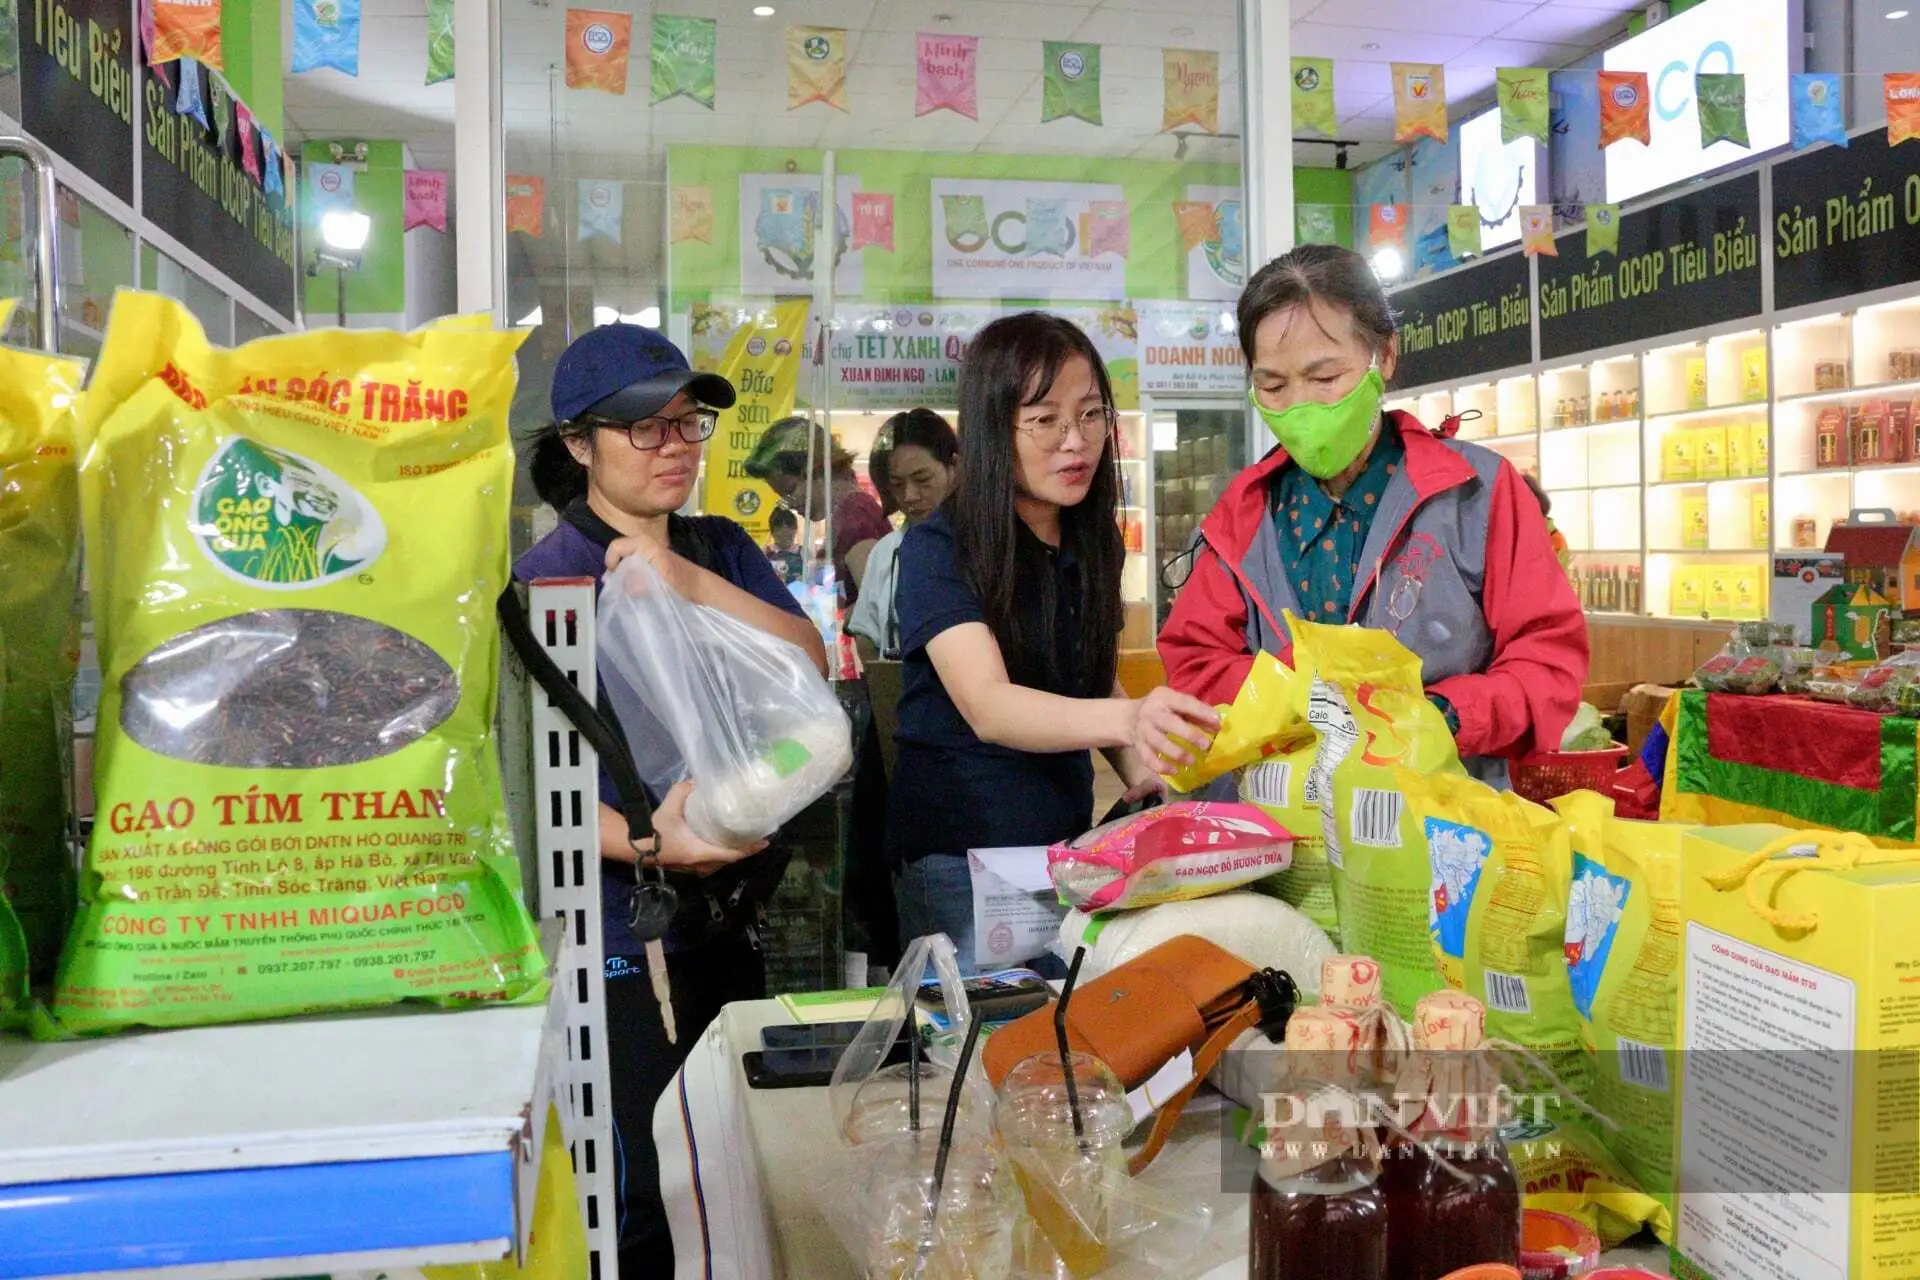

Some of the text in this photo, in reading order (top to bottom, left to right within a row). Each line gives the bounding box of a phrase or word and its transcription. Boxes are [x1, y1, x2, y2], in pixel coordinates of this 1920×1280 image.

[925, 42, 967, 60] Minh
[88, 18, 131, 125] Biểu
[1777, 205, 1818, 258] Sản
[1826, 176, 1895, 246] Phẩm
[1541, 216, 1757, 320] Sản Phẩm OCOP Tiêu Biểu
[1403, 283, 1529, 354] Phẩm OCOP Tiêu Biểu
[892, 335, 941, 360] XANH
[1145, 346, 1206, 367] DOANH
[740, 368, 774, 397] Đặc
[361, 379, 469, 424] TRĂNG
[351, 427, 379, 440] NAM
[400, 464, 422, 477] ISO
[110, 784, 446, 838] GẠO TÍM THAN
[166, 842, 178, 856] &
[306, 835, 352, 850] DNTN
[385, 832, 443, 847] QUANG
[127, 865, 153, 881] 196
[158, 863, 217, 883] đường
[276, 878, 311, 895] Sóc
[103, 912, 167, 936] CÔNG
[176, 915, 212, 934] TY
[220, 909, 299, 932] TNHH
[308, 892, 466, 926] MIQUAFOOD
[1424, 1016, 1453, 1037] LOVE
